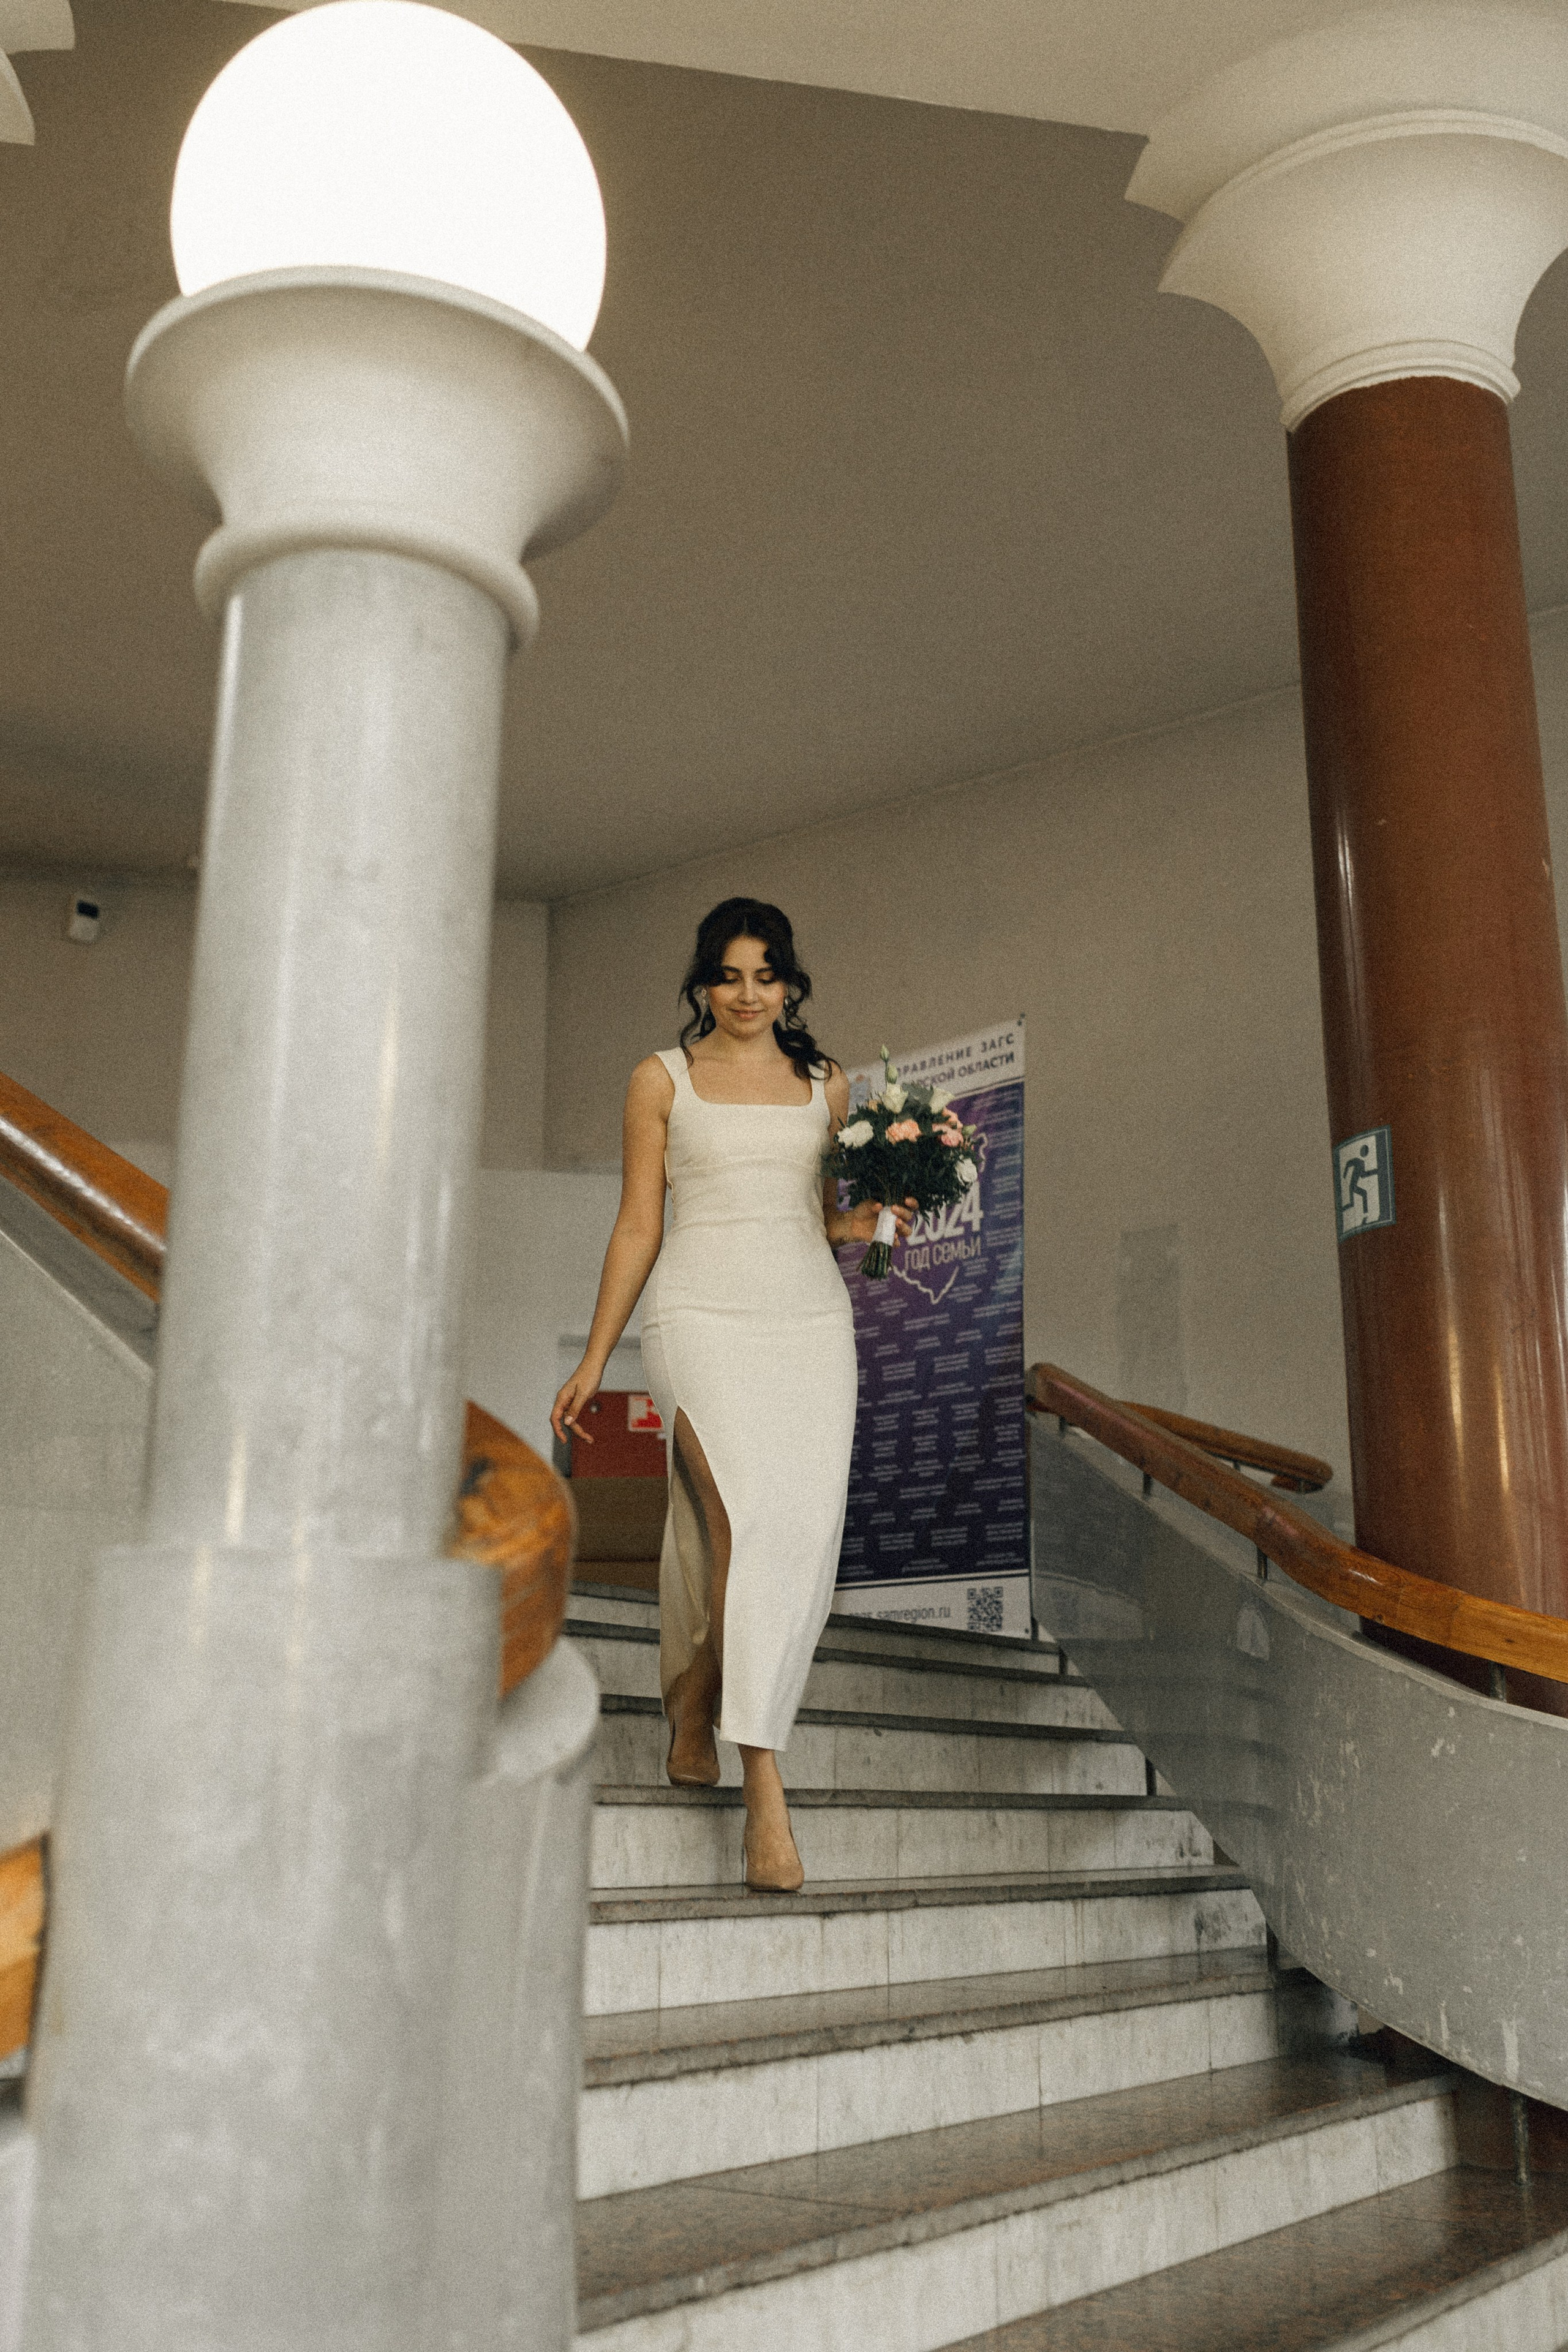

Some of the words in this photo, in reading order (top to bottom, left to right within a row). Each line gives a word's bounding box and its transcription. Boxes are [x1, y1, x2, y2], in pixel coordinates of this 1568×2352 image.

[981, 1033, 1014, 1054] ЗАГС
[958, 1051, 1014, 1078] ОБЛАСТИ
[905, 1246, 930, 1272] ГОД
